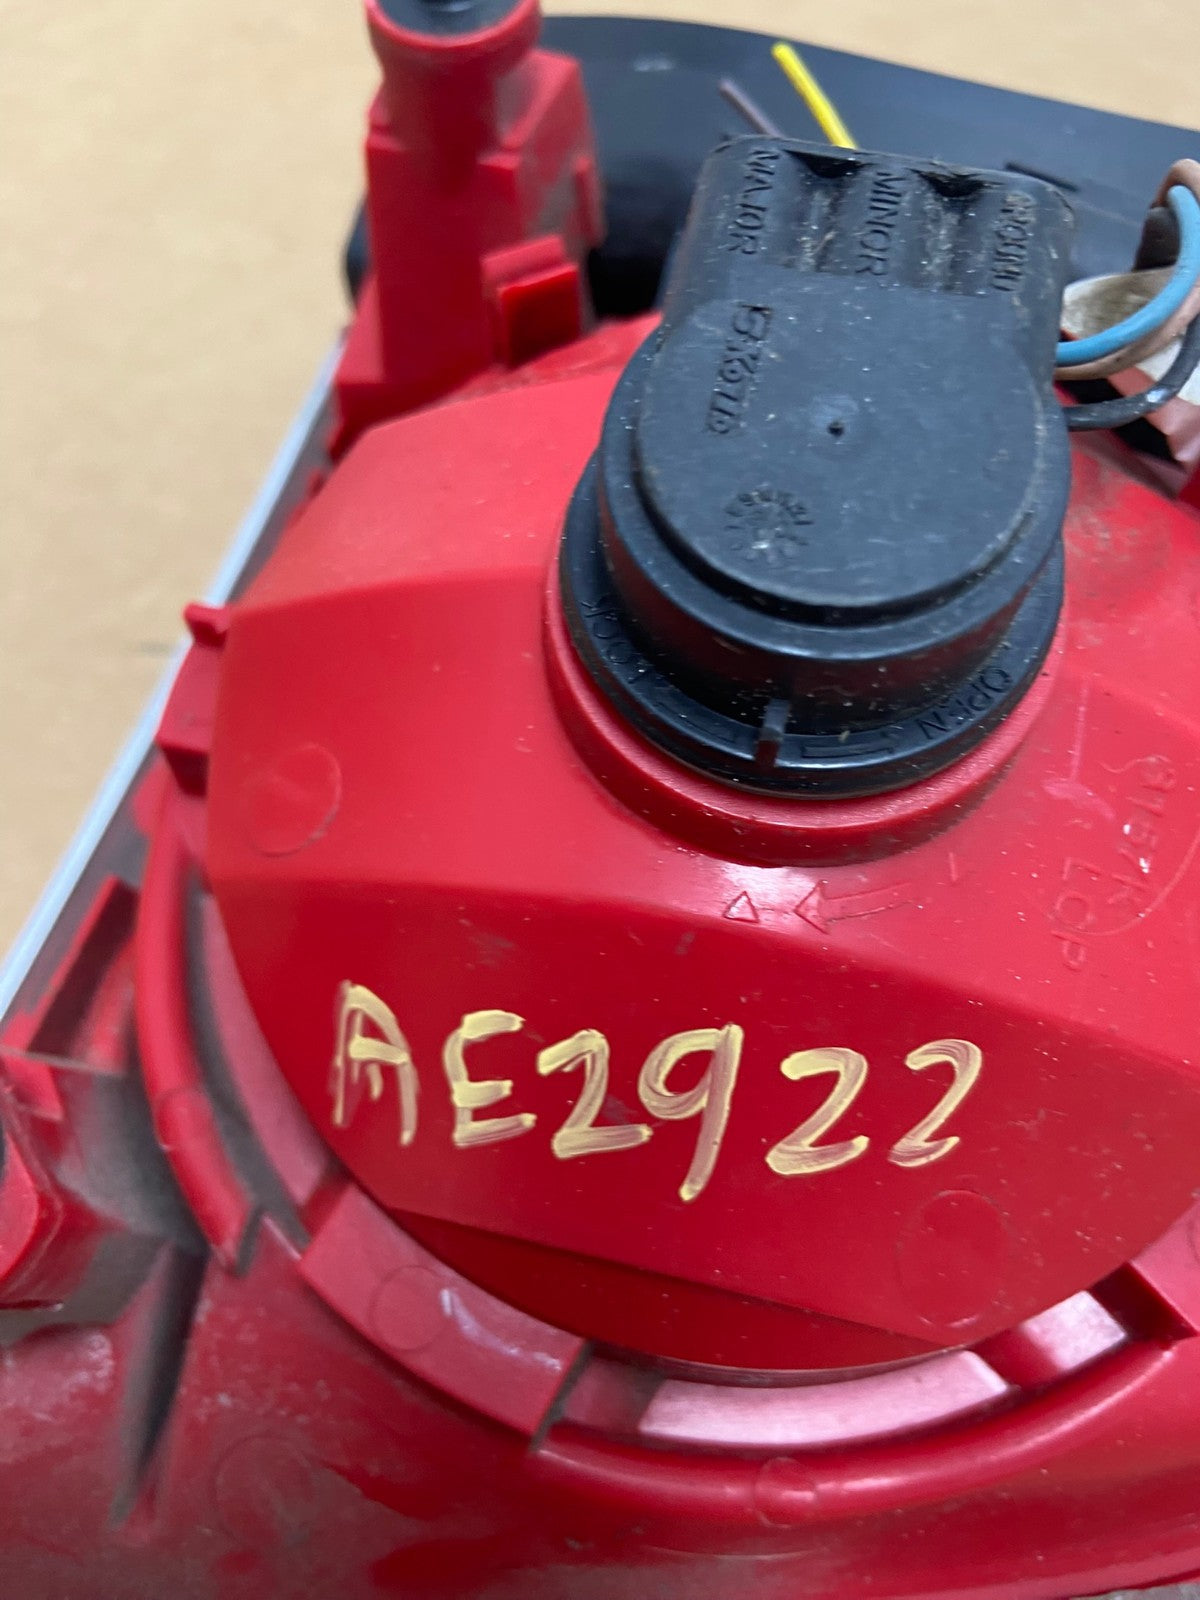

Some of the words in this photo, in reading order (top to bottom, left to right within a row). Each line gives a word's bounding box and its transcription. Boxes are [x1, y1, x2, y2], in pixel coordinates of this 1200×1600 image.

[727, 148, 783, 256] MAJOR
[855, 171, 905, 277] MINOR
[332, 979, 983, 1204] AE2922
